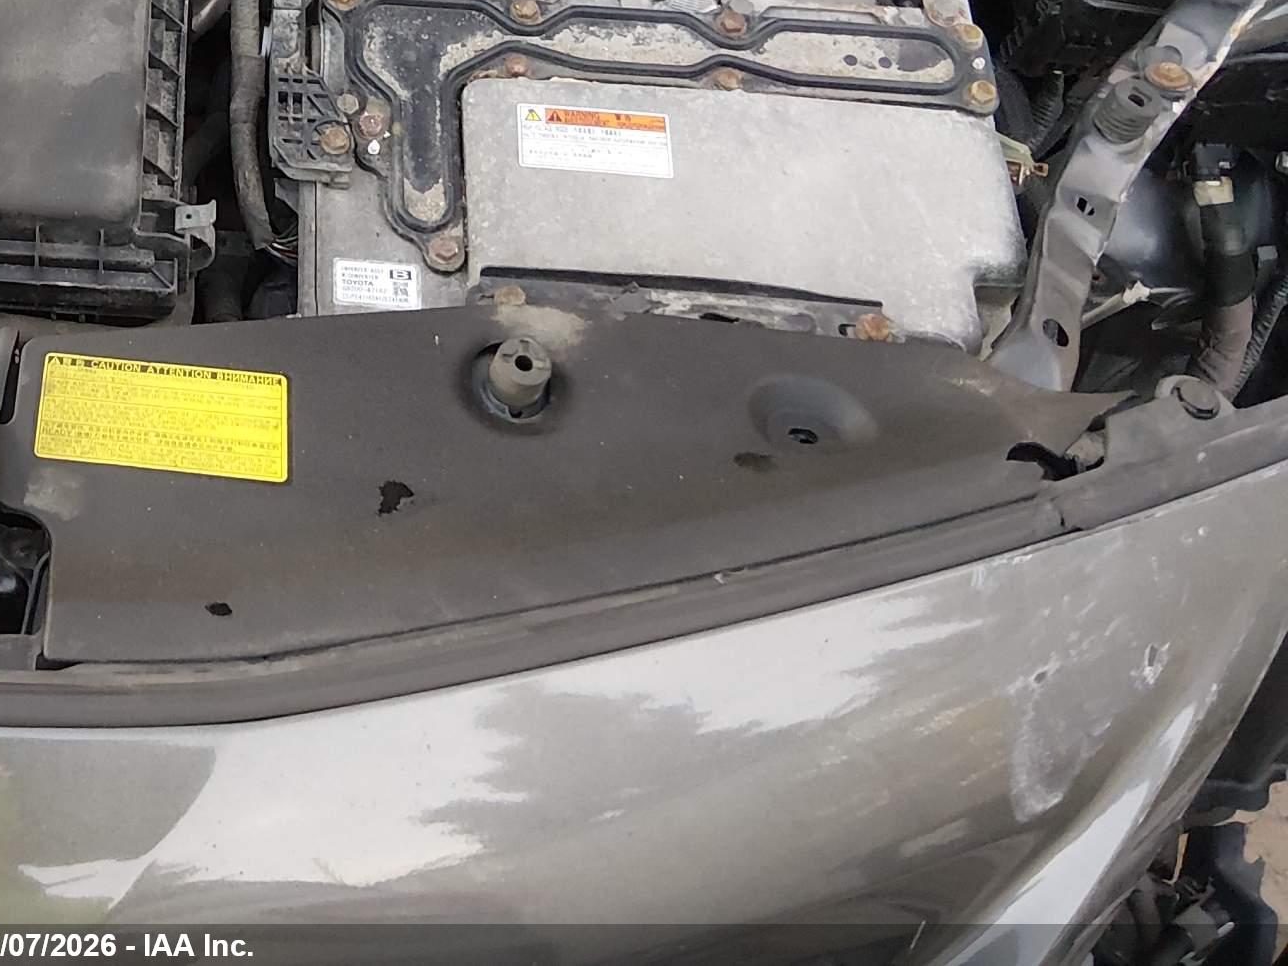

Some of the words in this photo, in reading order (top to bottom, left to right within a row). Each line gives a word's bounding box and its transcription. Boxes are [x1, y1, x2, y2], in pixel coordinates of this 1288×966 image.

[342, 279, 374, 287] TOYOTA
[92, 360, 141, 373] CAUTION
[146, 366, 212, 380] ATTENTION
[216, 372, 281, 387] ВНИМАНИЕ
